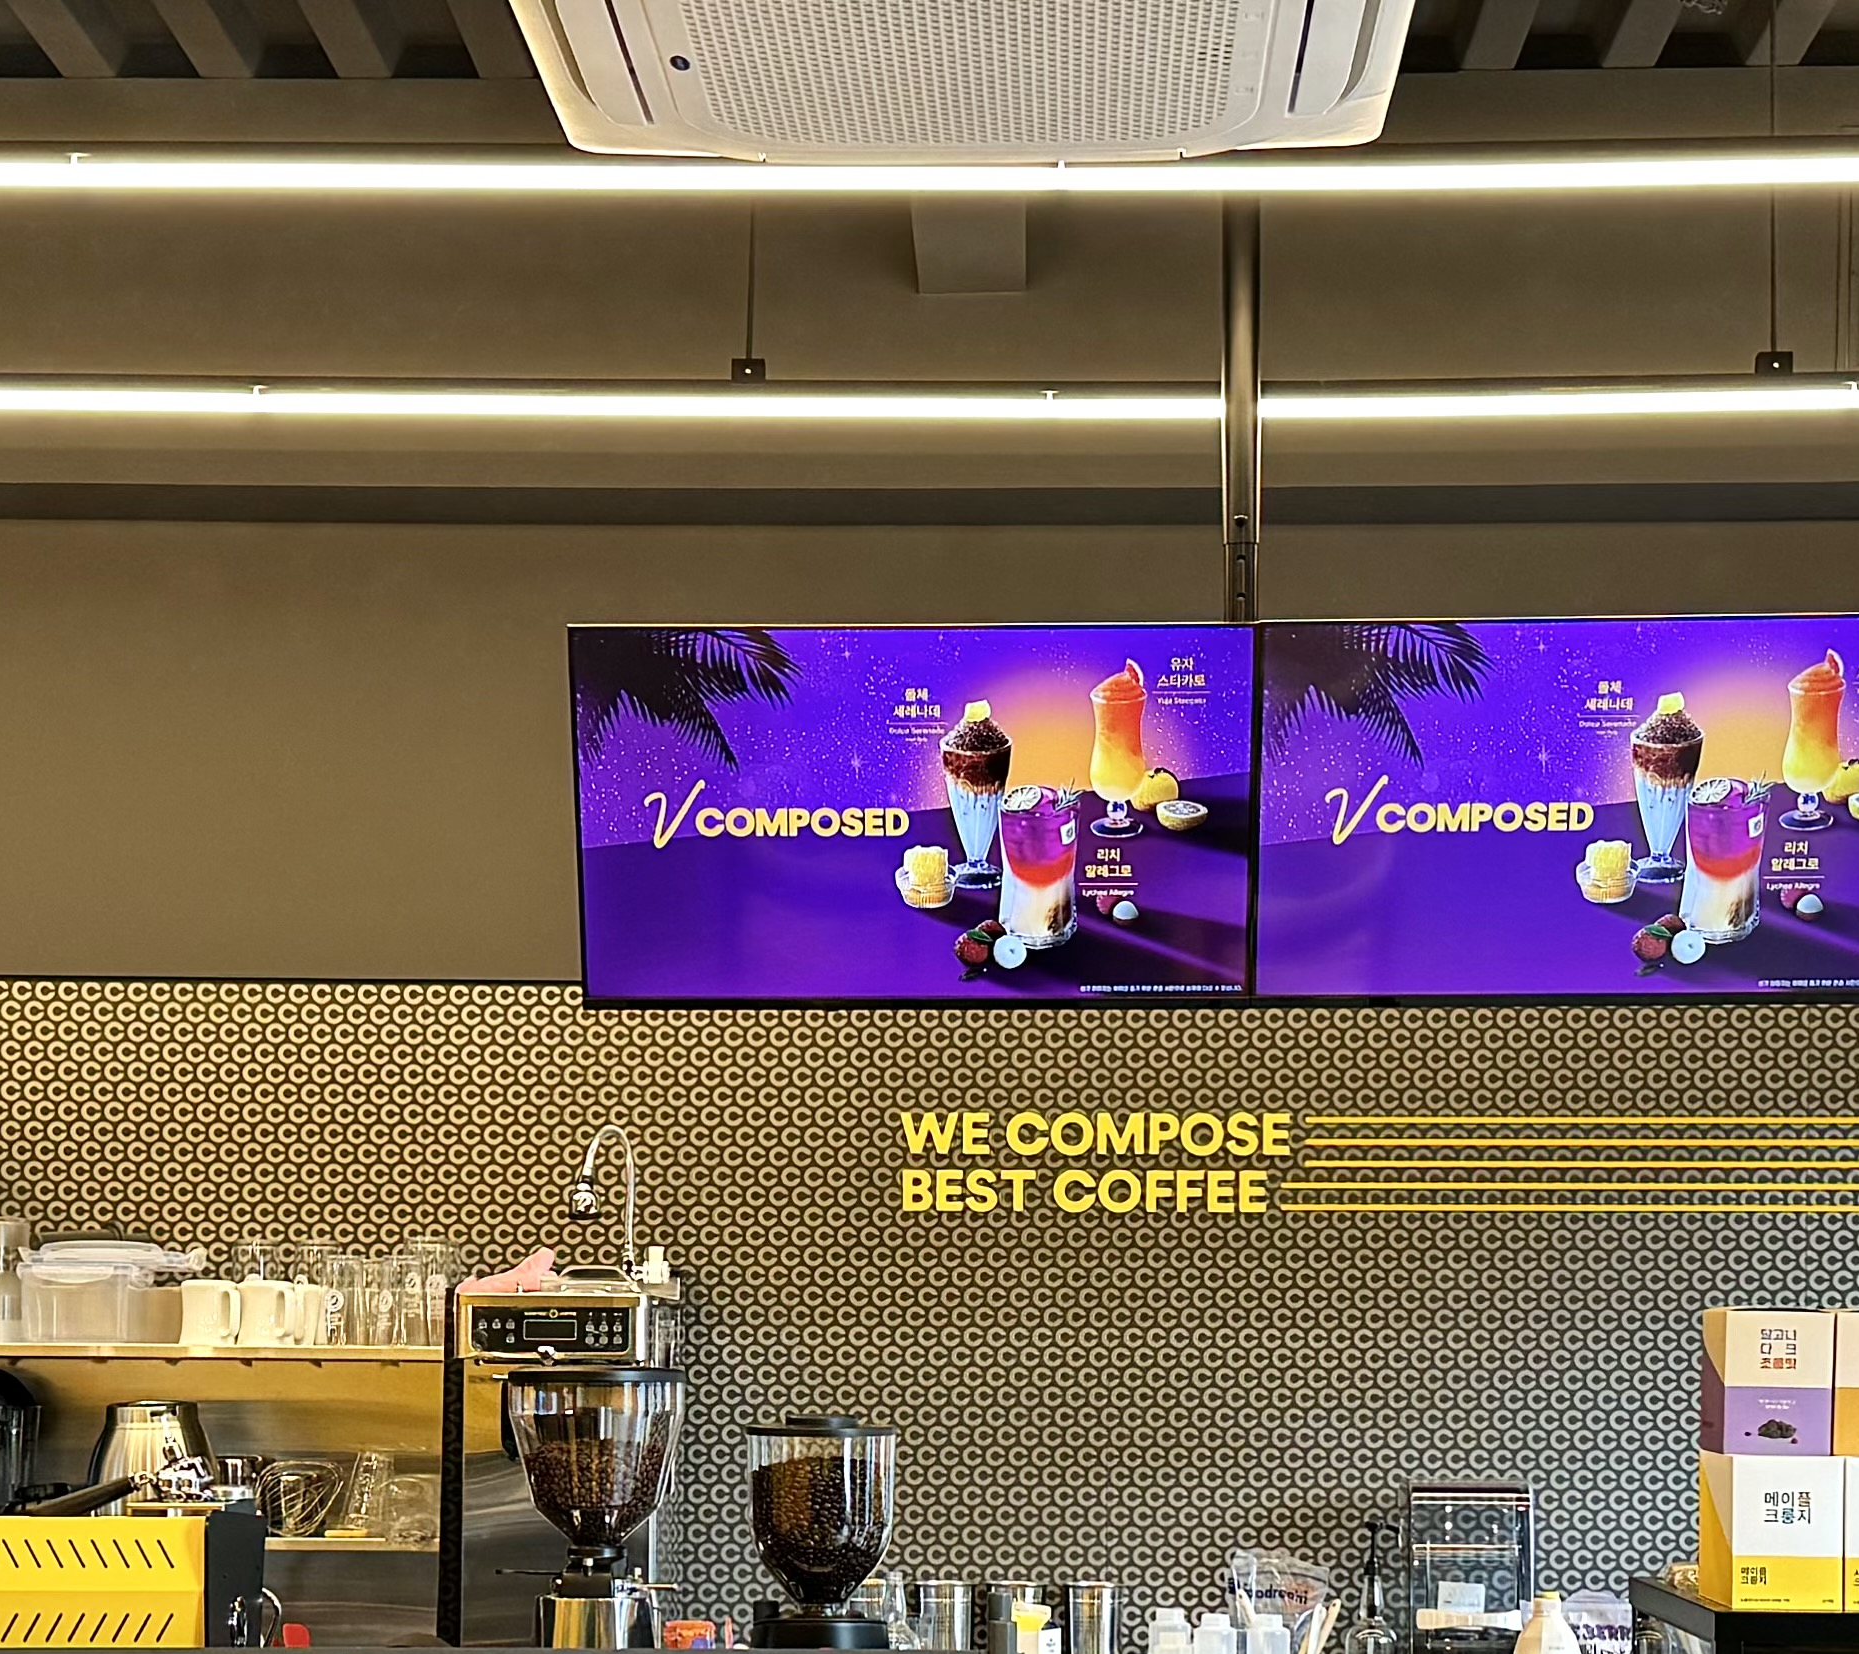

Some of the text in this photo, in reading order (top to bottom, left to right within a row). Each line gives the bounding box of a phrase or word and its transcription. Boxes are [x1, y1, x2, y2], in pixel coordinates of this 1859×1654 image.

[1170, 657, 1193, 671] 유자
[695, 807, 910, 837] COMPOSED
[1376, 801, 1594, 833] COMPOSED
[1096, 848, 1120, 862] 리치
[1784, 841, 1808, 855] 리치
[901, 1111, 1291, 1156] WE COMPOSE
[902, 1169, 1267, 1213] BEST COFFEE
[1764, 1491, 1811, 1508] 메이플
